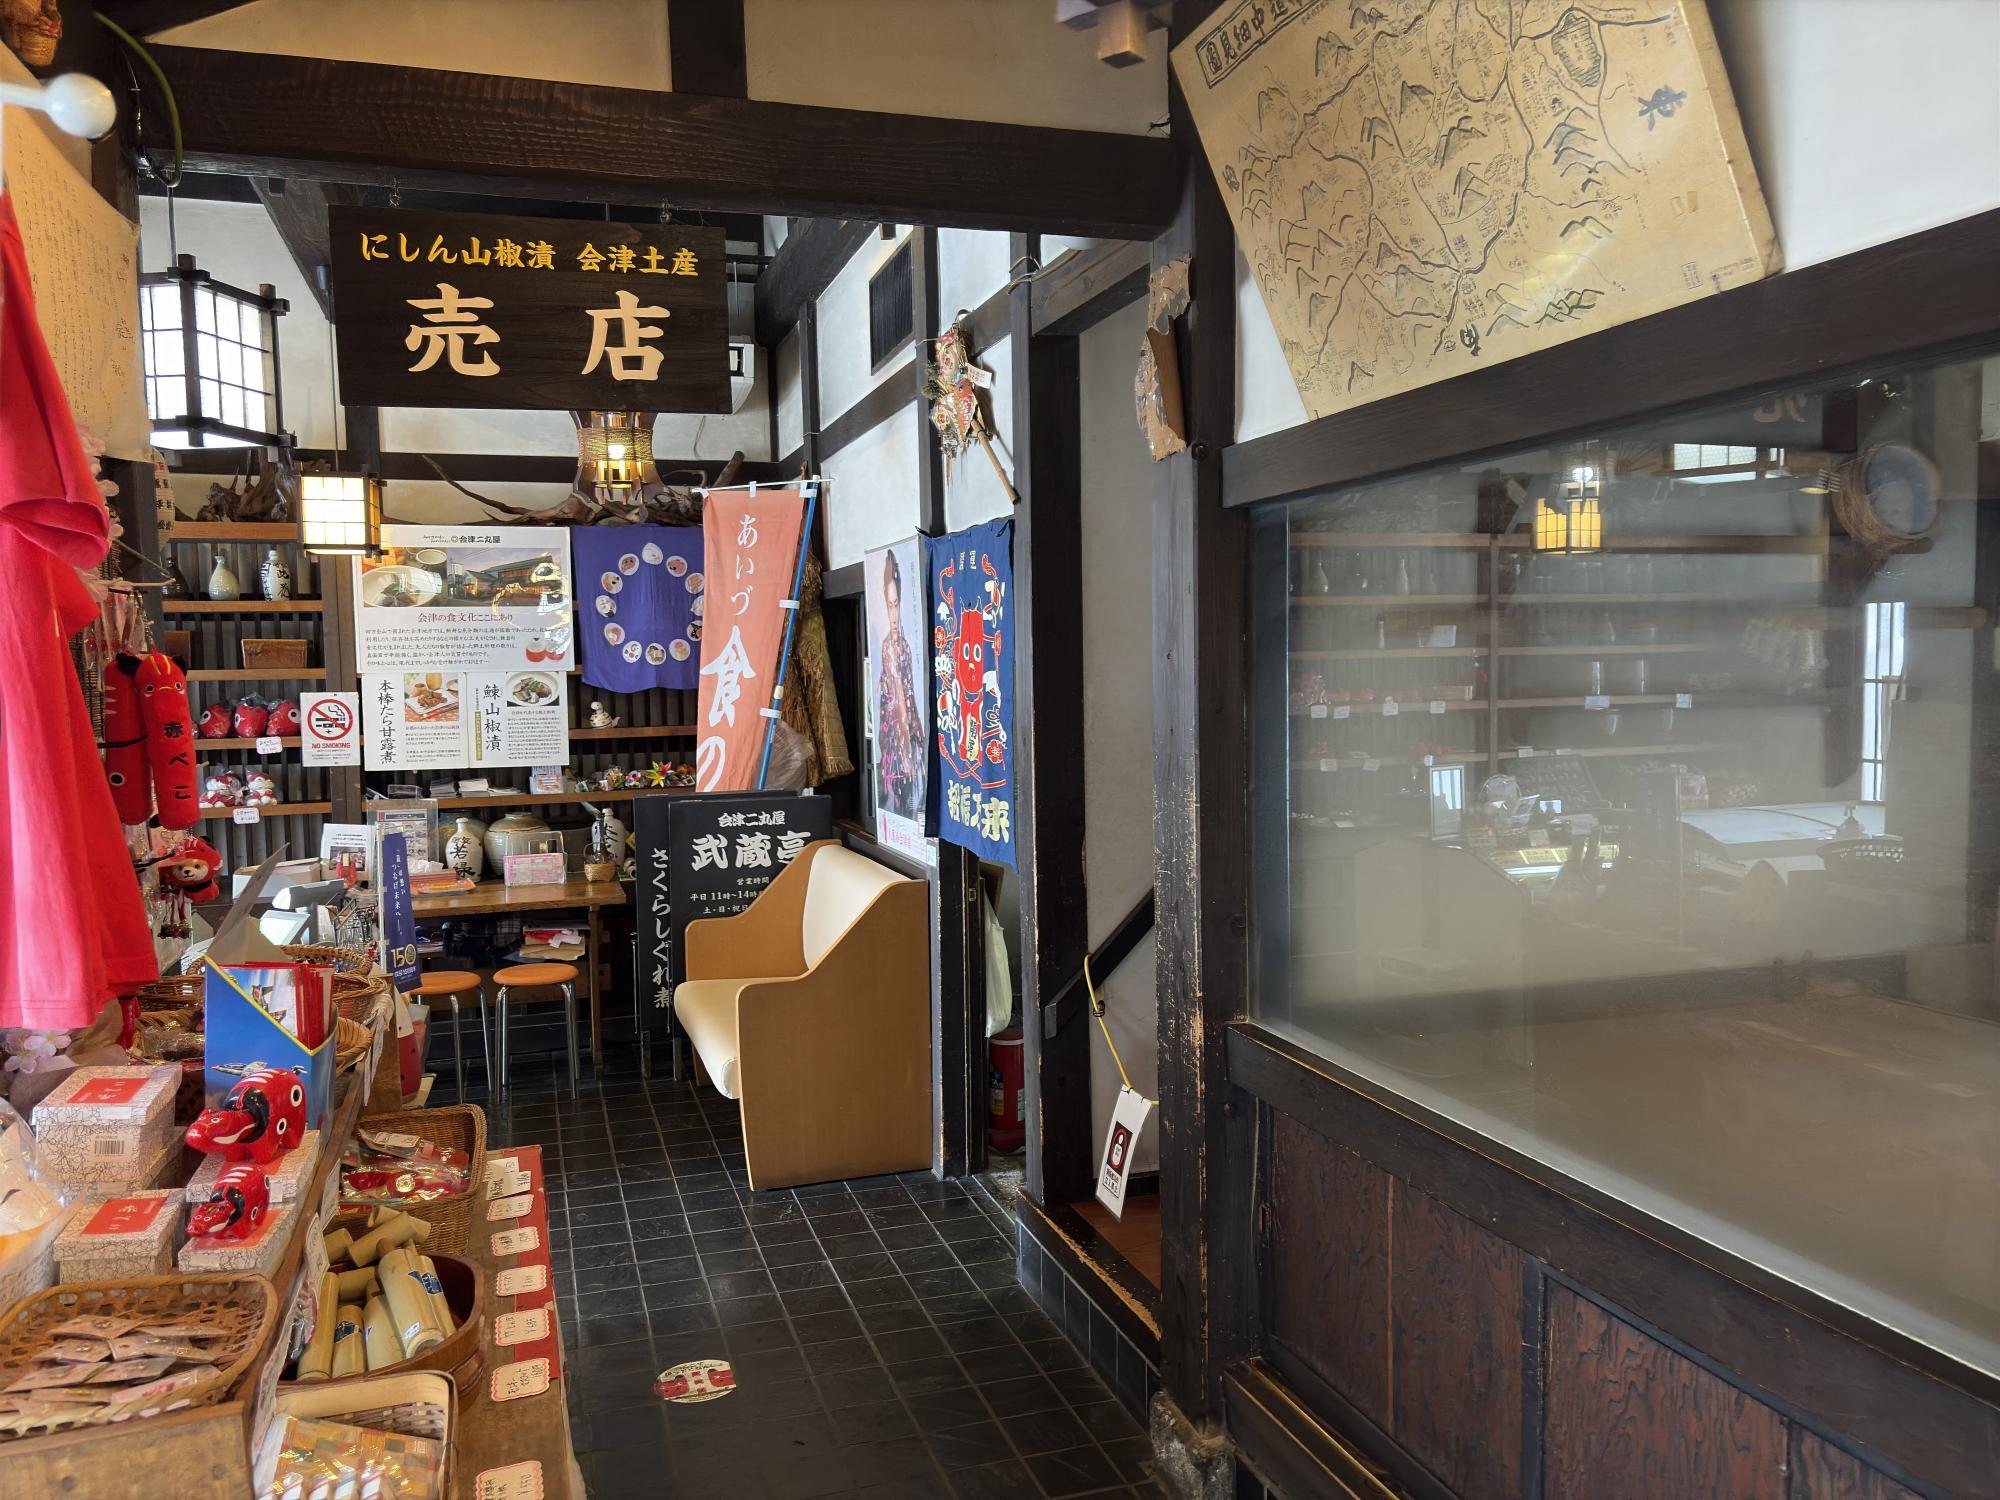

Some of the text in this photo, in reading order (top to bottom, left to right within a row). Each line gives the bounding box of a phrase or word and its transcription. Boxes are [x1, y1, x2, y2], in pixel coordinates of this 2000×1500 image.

[360, 232, 699, 276] にしん山椒漬 会津土産
[418, 612, 513, 623] 会津の食文化ここにあり
[379, 680, 396, 764] 本棒たら甘露煮
[483, 684, 503, 752] 鰊山椒漬
[163, 721, 191, 800] 赤べこ
[717, 810, 786, 828] 会津二丸屋
[691, 830, 811, 871] 武蔵亭
[690, 893, 707, 902] 平日
[736, 876, 769, 886] 営業時間
[391, 943, 417, 969] 150
